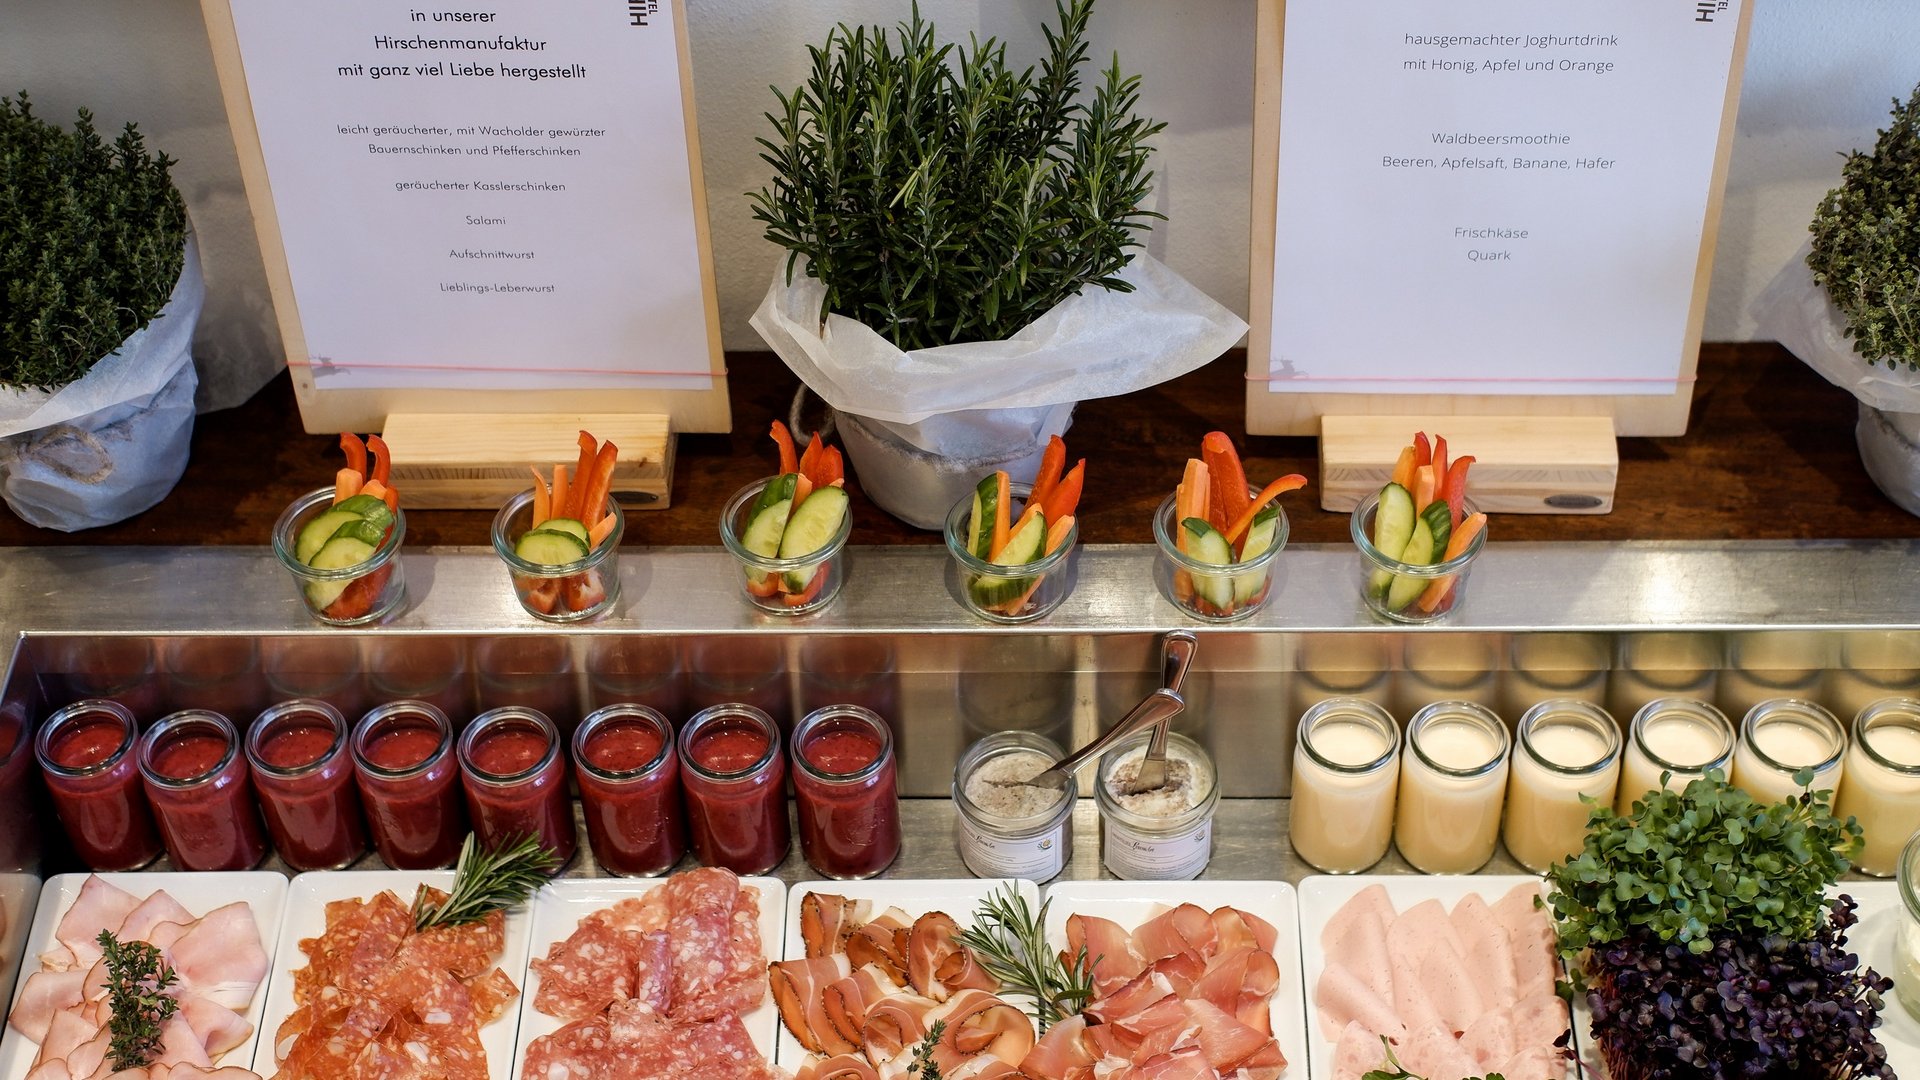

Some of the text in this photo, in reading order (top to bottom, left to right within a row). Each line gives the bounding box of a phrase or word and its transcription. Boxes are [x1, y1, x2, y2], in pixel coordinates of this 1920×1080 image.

[410, 9, 496, 22] in unserer
[375, 35, 546, 51] Hirschenmanufaktur
[1405, 33, 1618, 49] hausgemachter Joghurtdrink
[338, 62, 586, 81] mit ganz viel Liebe hergestellt
[1403, 58, 1614, 75] mit Honig, Apfel und Orange
[337, 123, 605, 140] leicht geräucherter, mit Wacholder gewürzter
[1432, 132, 1571, 145] Waldbeersmoothie
[368, 144, 581, 157] Bauernschinken und Pfefferschinken
[1382, 156, 1616, 172] Beeren, Apfelsaft, Banane, Hafer
[395, 180, 566, 192] geräucherter Kasslerschinken
[465, 215, 506, 226] Salami
[1454, 227, 1529, 239] Frischkäse
[449, 249, 535, 260] Aufschnittwurst
[1467, 249, 1511, 262] Quark
[440, 283, 555, 295] Lieblings-Leberwurst
